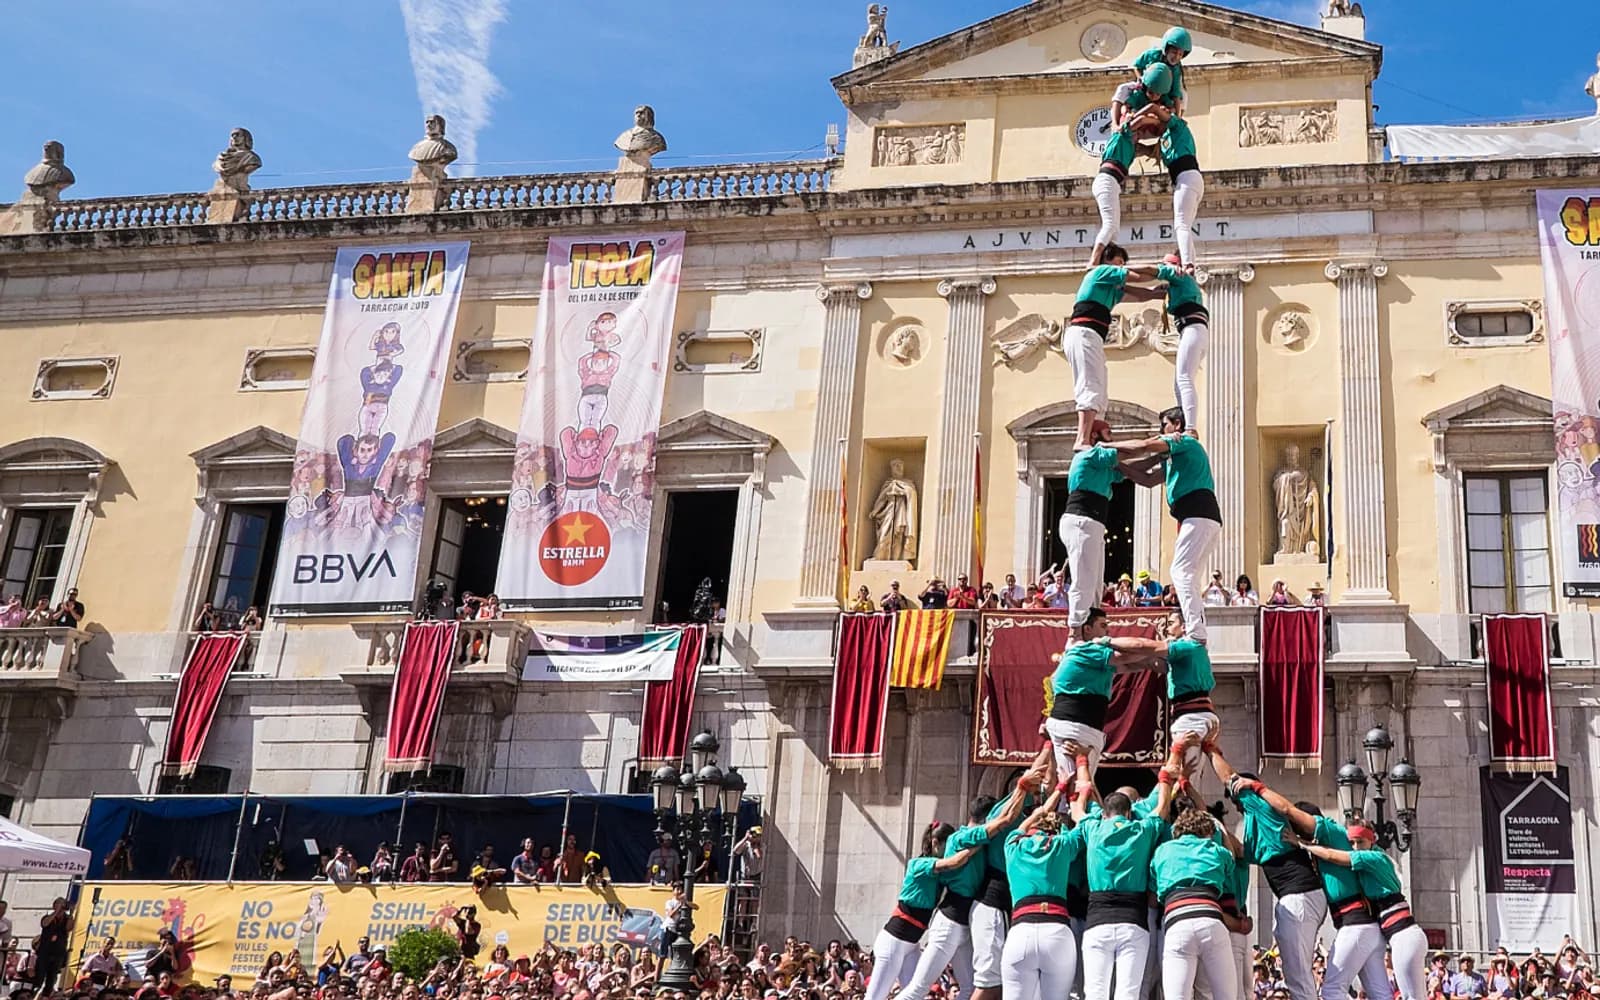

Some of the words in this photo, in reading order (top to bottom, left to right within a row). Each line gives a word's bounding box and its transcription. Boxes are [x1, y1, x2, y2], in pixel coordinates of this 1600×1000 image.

[1100, 110, 1109, 119] 12
[1083, 120, 1091, 128] 10
[963, 221, 1230, 249] AJVNTMENT
[1580, 250, 1600, 260] TAR
[570, 240, 656, 289] TECLA
[353, 250, 447, 300] SANTA
[360, 302, 409, 313] TARRAGONA
[542, 546, 605, 560] ESTRELLA
[293, 549, 397, 585] BBVA
[562, 559, 585, 567] DAMM
[1507, 816, 1560, 824] TARRAGONA
[22, 858, 86, 871] www.tac12.tv
[1503, 867, 1551, 878] Respecta
[93, 899, 165, 918] SIGUES
[240, 900, 273, 918] NO
[236, 916, 261, 939] ÉS
[265, 921, 297, 940] NO
[544, 924, 572, 943] DE
[576, 924, 619, 943] BUS
[235, 942, 250, 951] VIU
[252, 942, 269, 951] LES
[233, 953, 265, 963] FESTES
